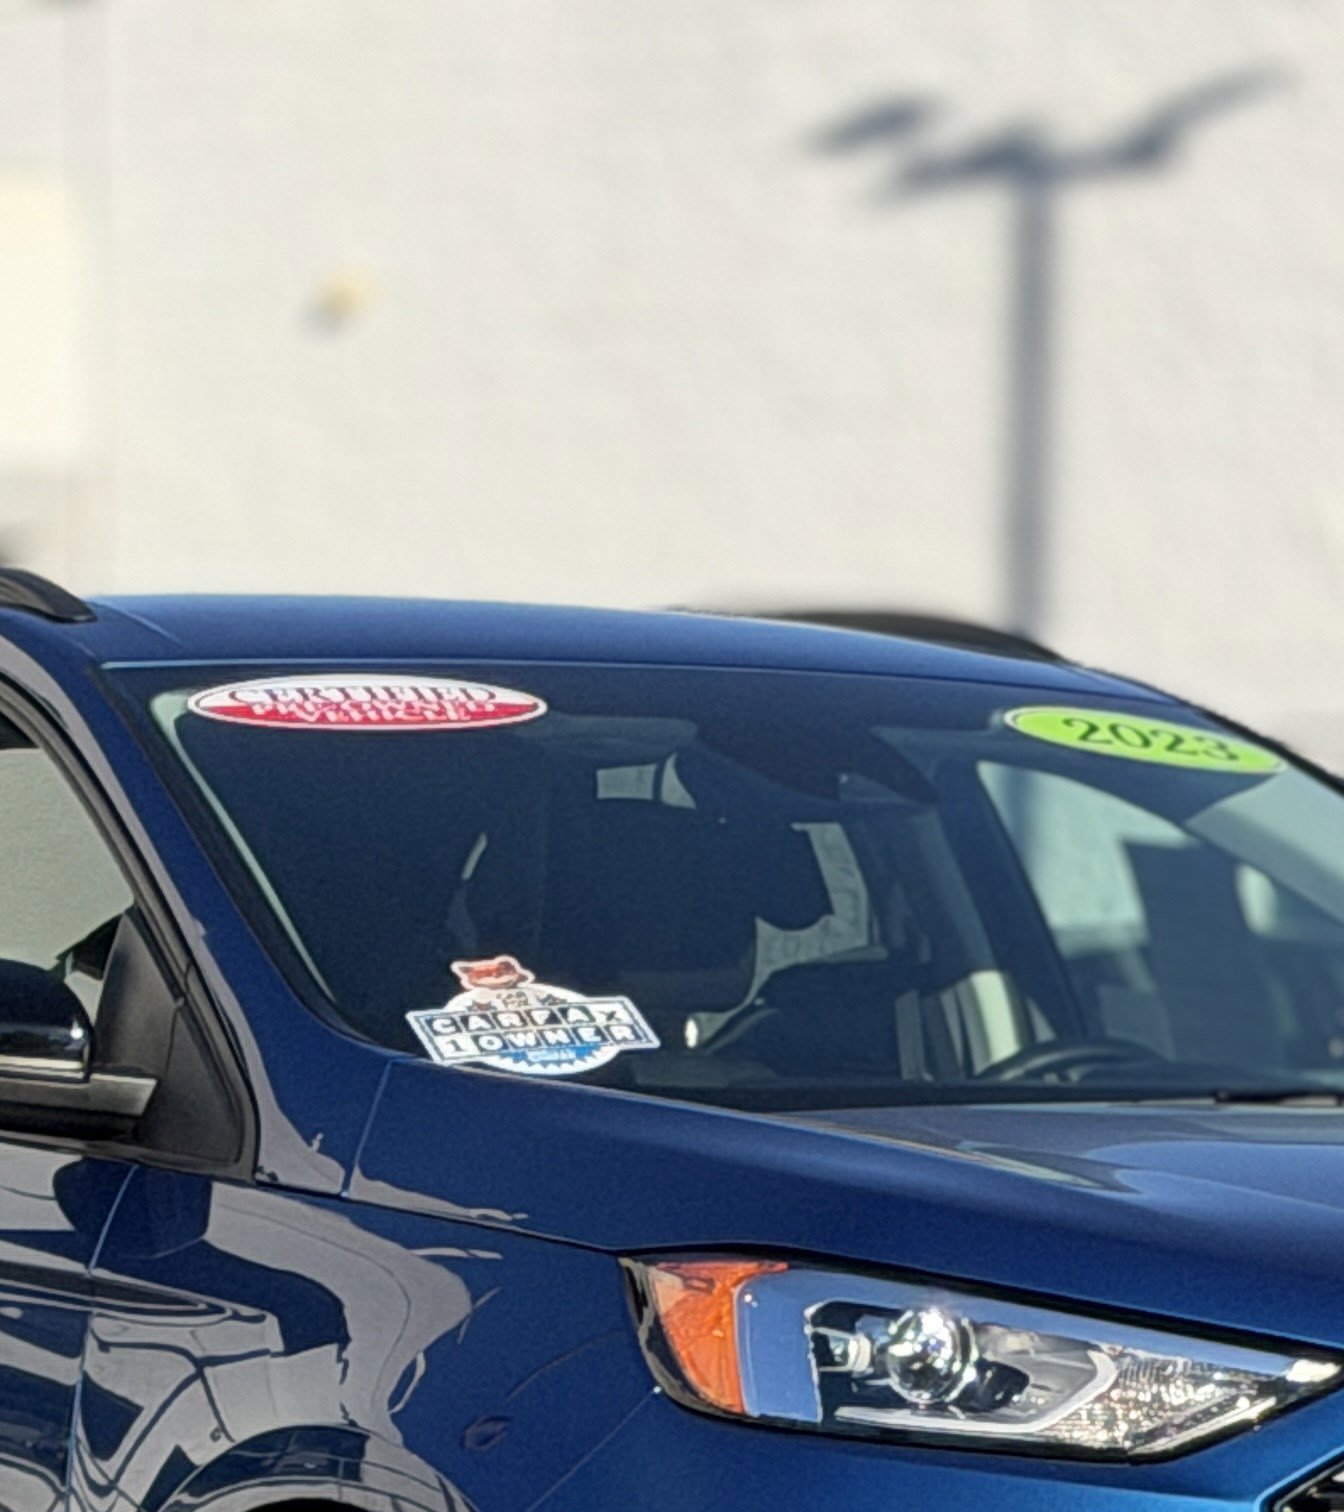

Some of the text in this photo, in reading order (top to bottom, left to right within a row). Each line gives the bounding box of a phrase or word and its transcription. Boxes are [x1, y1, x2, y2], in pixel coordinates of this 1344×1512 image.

[1062, 716, 1239, 761] 2023
[429, 1006, 624, 1035] CARFAX
[476, 1024, 638, 1052] OWNER
